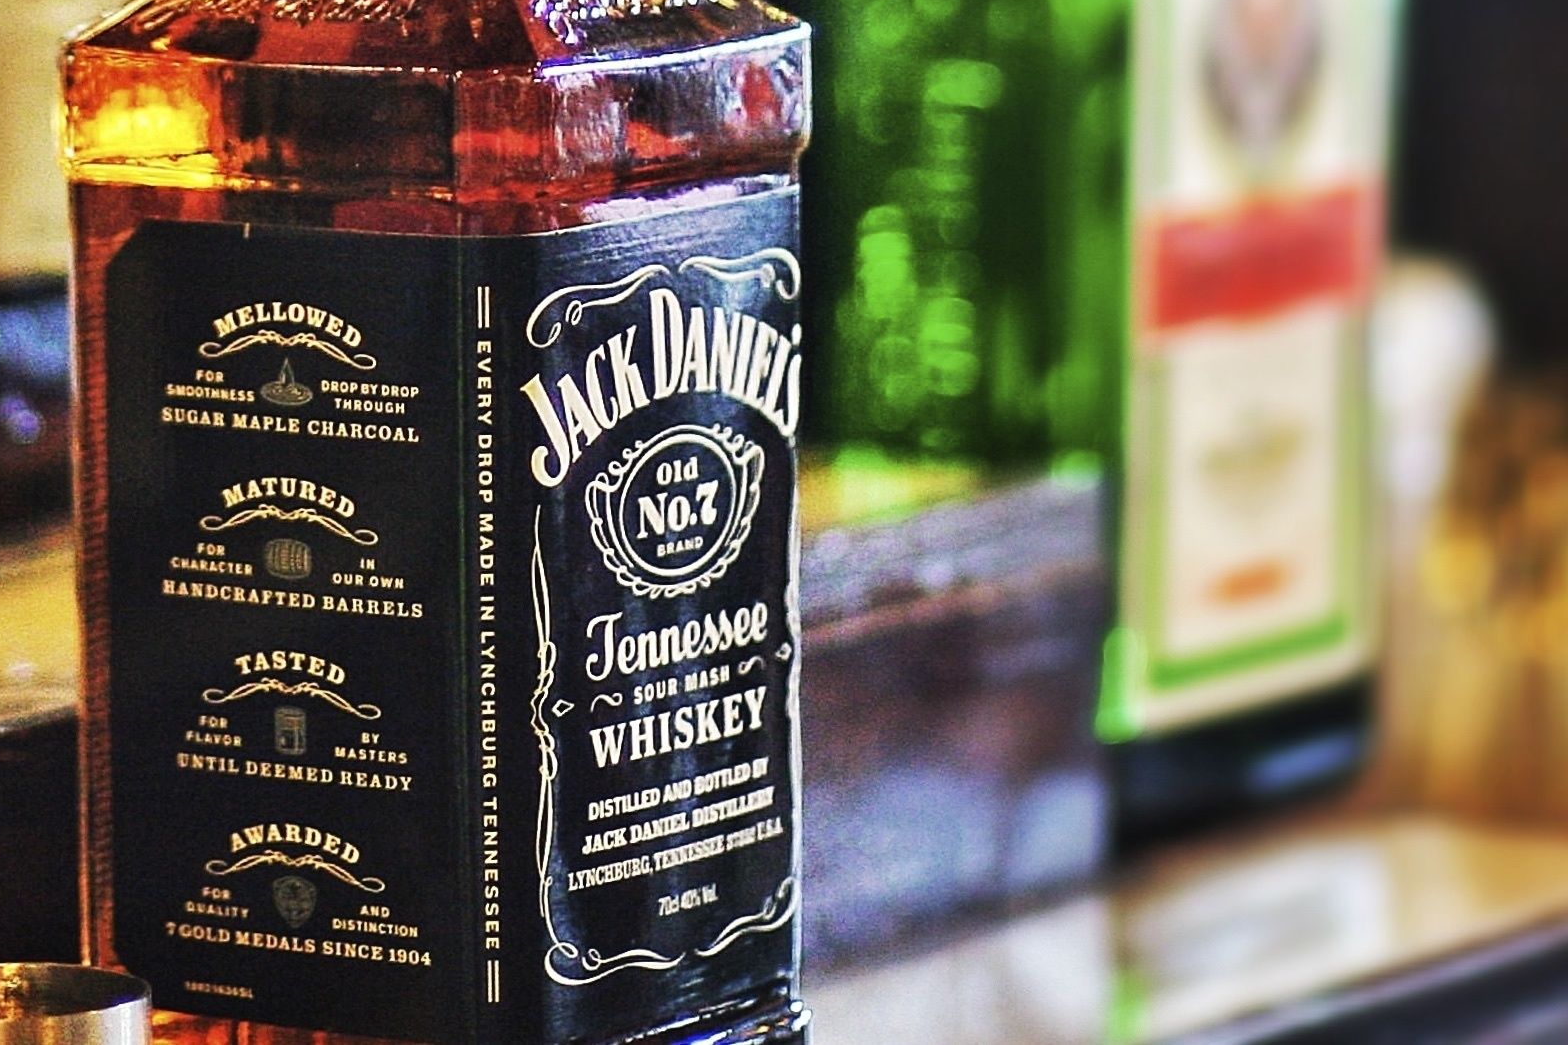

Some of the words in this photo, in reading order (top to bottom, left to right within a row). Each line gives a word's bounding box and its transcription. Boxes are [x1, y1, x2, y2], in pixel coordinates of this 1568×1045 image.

[212, 301, 363, 348] MELLOWED
[165, 383, 256, 403] SMOOTHNESS
[195, 369, 225, 383] FOR
[321, 379, 359, 395] DROP
[360, 383, 378, 396] BY
[381, 384, 420, 399] DROP
[476, 339, 493, 427] EVERY
[334, 398, 406, 414] THROUGH
[520, 324, 651, 487] JACK
[161, 406, 226, 427] SUGAR
[232, 412, 300, 434] MAPLE
[307, 419, 420, 443] CHARCOAL
[477, 433, 494, 505] DROP
[655, 455, 699, 487] Old
[221, 476, 356, 519] MATURED
[196, 542, 226, 556] FOR
[360, 558, 376, 570] IN
[478, 512, 495, 587] MADE
[656, 535, 704, 558] BRAND
[169, 556, 254, 576] CHARACTER
[332, 572, 364, 587] OUR
[369, 575, 405, 590] OWN
[161, 579, 316, 609] HANDCRAFTED
[322, 595, 424, 619] BARRELS
[479, 595, 495, 621] IN
[585, 601, 769, 682] Tennessee
[234, 650, 346, 685] TASTED
[633, 676, 679, 705] SOUR
[684, 664, 731, 692] MASH
[199, 715, 229, 729] FOR
[480, 631, 498, 788] LYNCHBURG
[588, 685, 768, 769] WHISKEY
[185, 729, 243, 747] FLAVOR
[361, 731, 380, 744] BY
[175, 752, 240, 773] UNTIL
[245, 759, 334, 784] DEEMED
[340, 770, 414, 792] READY
[334, 746, 409, 765] MASTERS
[587, 787, 661, 822] DISTILLED
[661, 779, 693, 804] AND
[693, 764, 751, 797] BOTTLED
[752, 756, 770, 779] BY
[581, 829, 628, 856] JACK
[629, 812, 690, 844] DANIEL
[691, 785, 776, 829] DISTILLERY
[228, 823, 361, 865] AWARDED
[483, 796, 501, 950] TENNESSEE
[567, 856, 654, 892] LYNCHBURG,
[653, 834, 726, 871] TENNESSEE
[185, 900, 250, 918] QUALITY
[202, 886, 231, 900] FOR
[332, 917, 419, 938] DISTINCTION
[360, 904, 391, 918] AND
[178, 923, 231, 943] GOLD
[235, 929, 317, 954] MEDALS
[322, 940, 384, 961] SINCE
[388, 948, 432, 967] 1904
